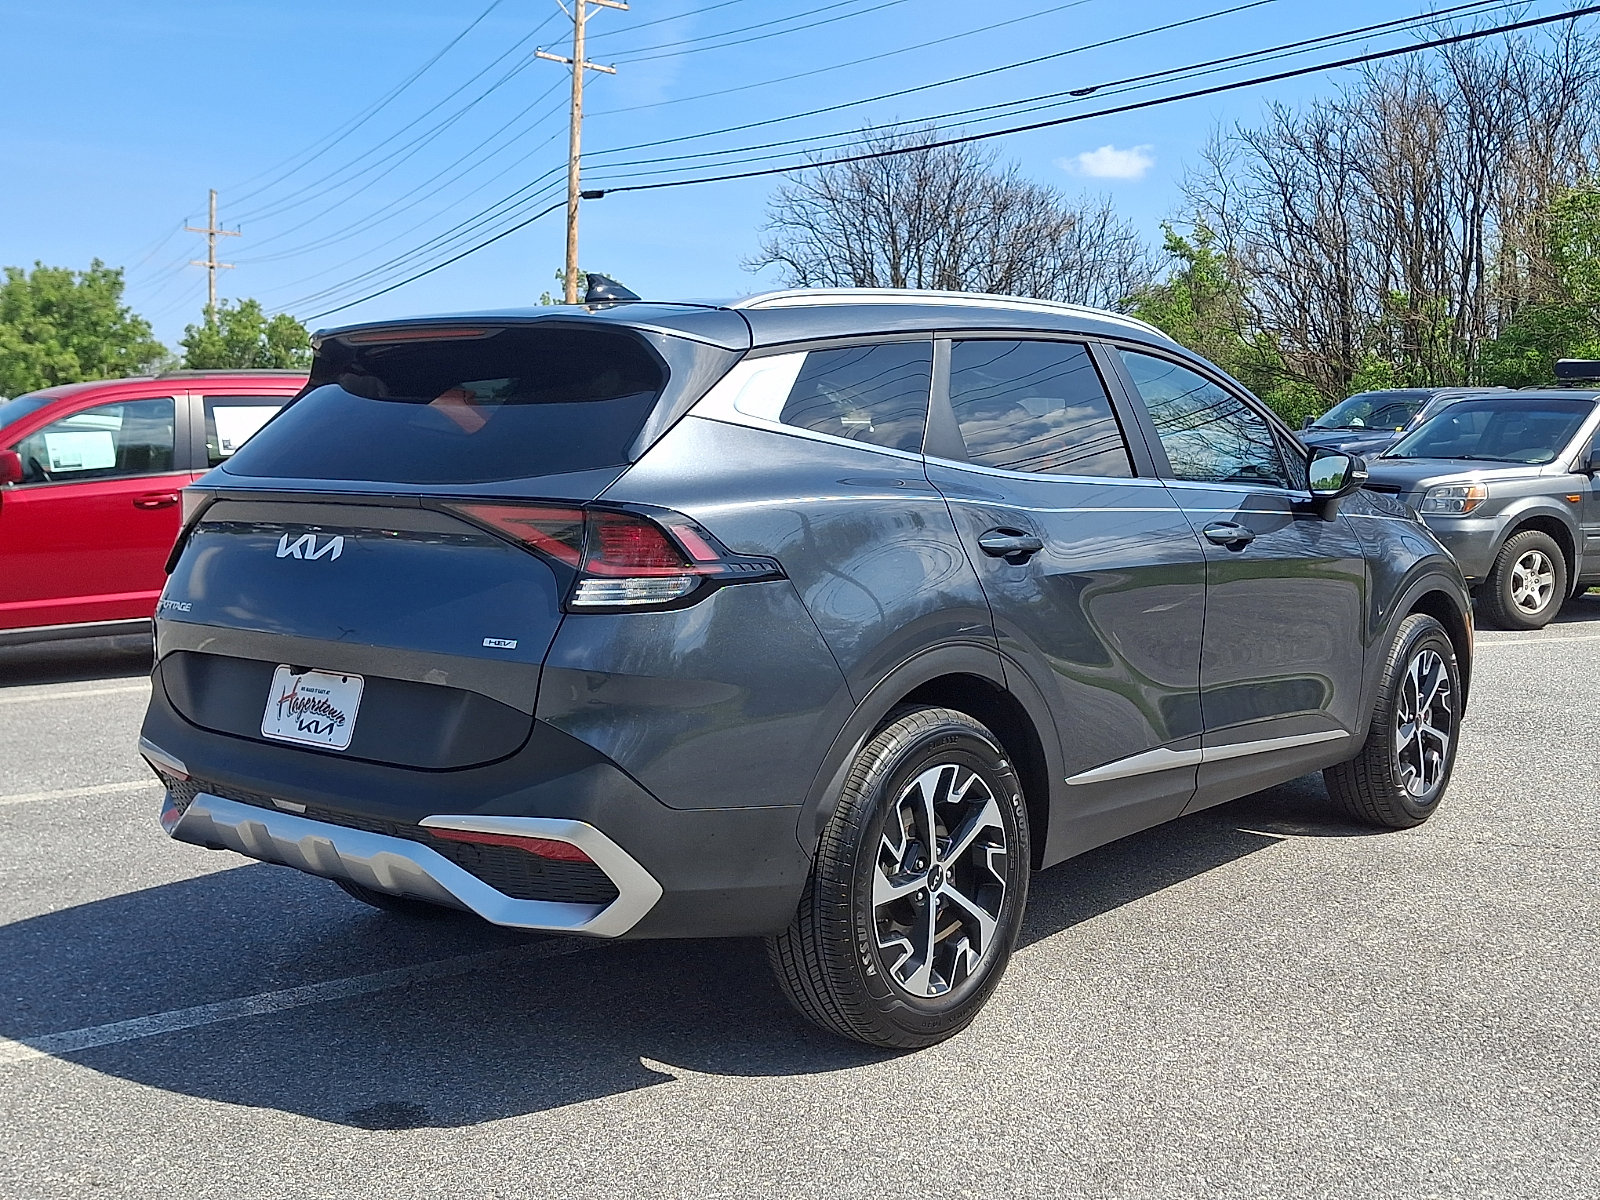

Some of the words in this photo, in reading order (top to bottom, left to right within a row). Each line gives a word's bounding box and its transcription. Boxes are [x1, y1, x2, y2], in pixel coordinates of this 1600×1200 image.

[276, 532, 345, 562] KIA
[277, 677, 346, 726] Hagerstown
[298, 718, 334, 735] KIA
